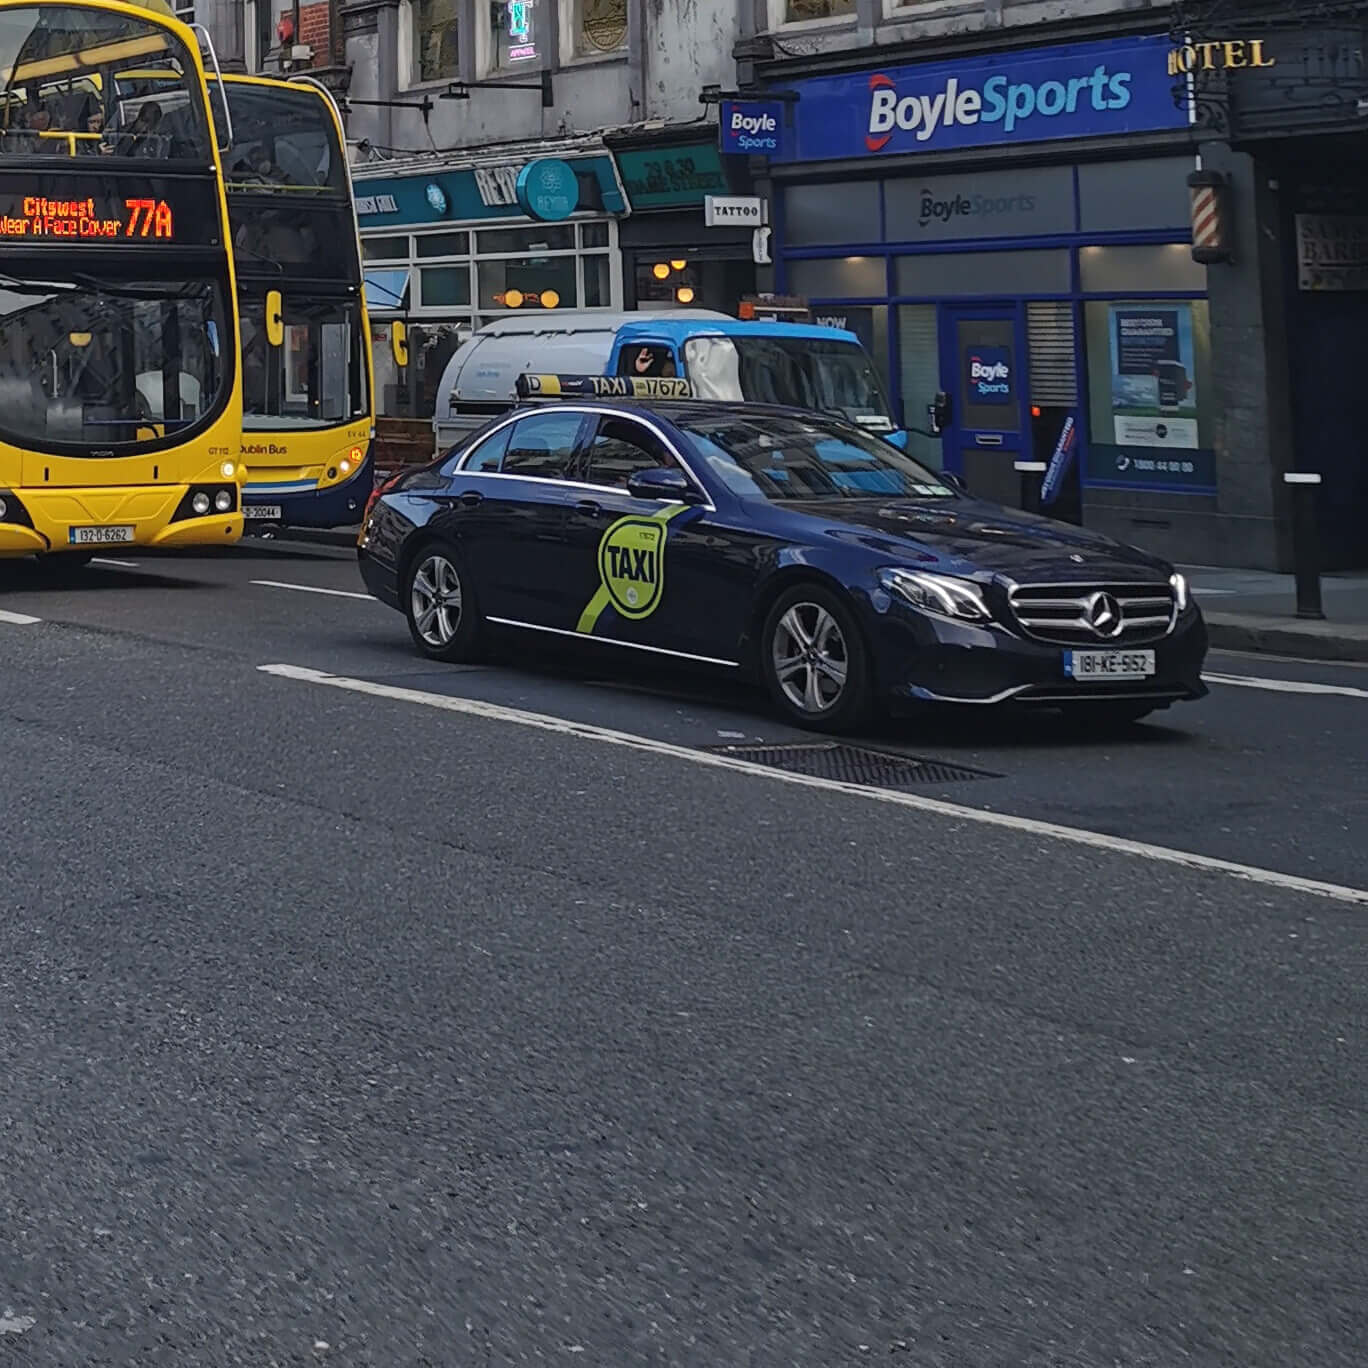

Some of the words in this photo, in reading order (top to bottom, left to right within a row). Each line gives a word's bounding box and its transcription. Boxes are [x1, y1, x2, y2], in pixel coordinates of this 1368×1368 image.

[1167, 40, 1275, 75] HOTEL
[870, 65, 1131, 141] BoyleSports
[732, 113, 776, 134] Boyle
[738, 135, 777, 150] Sports
[714, 205, 759, 217] TATTOO
[920, 194, 1036, 222] BoyleSports
[33, 216, 42, 235] A
[44, 216, 77, 236] Face
[80, 217, 122, 237] Cover
[125, 199, 173, 237] 77A
[816, 316, 848, 329] NOW
[972, 362, 1009, 381] Boyle
[529, 376, 541, 391] D
[589, 376, 627, 395] TAXI
[646, 379, 689, 397] 17672
[978, 381, 1009, 395] Sports
[269, 444, 288, 455] Bus
[80, 528, 127, 541] 132-D-6262
[608, 546, 654, 584] TAXI
